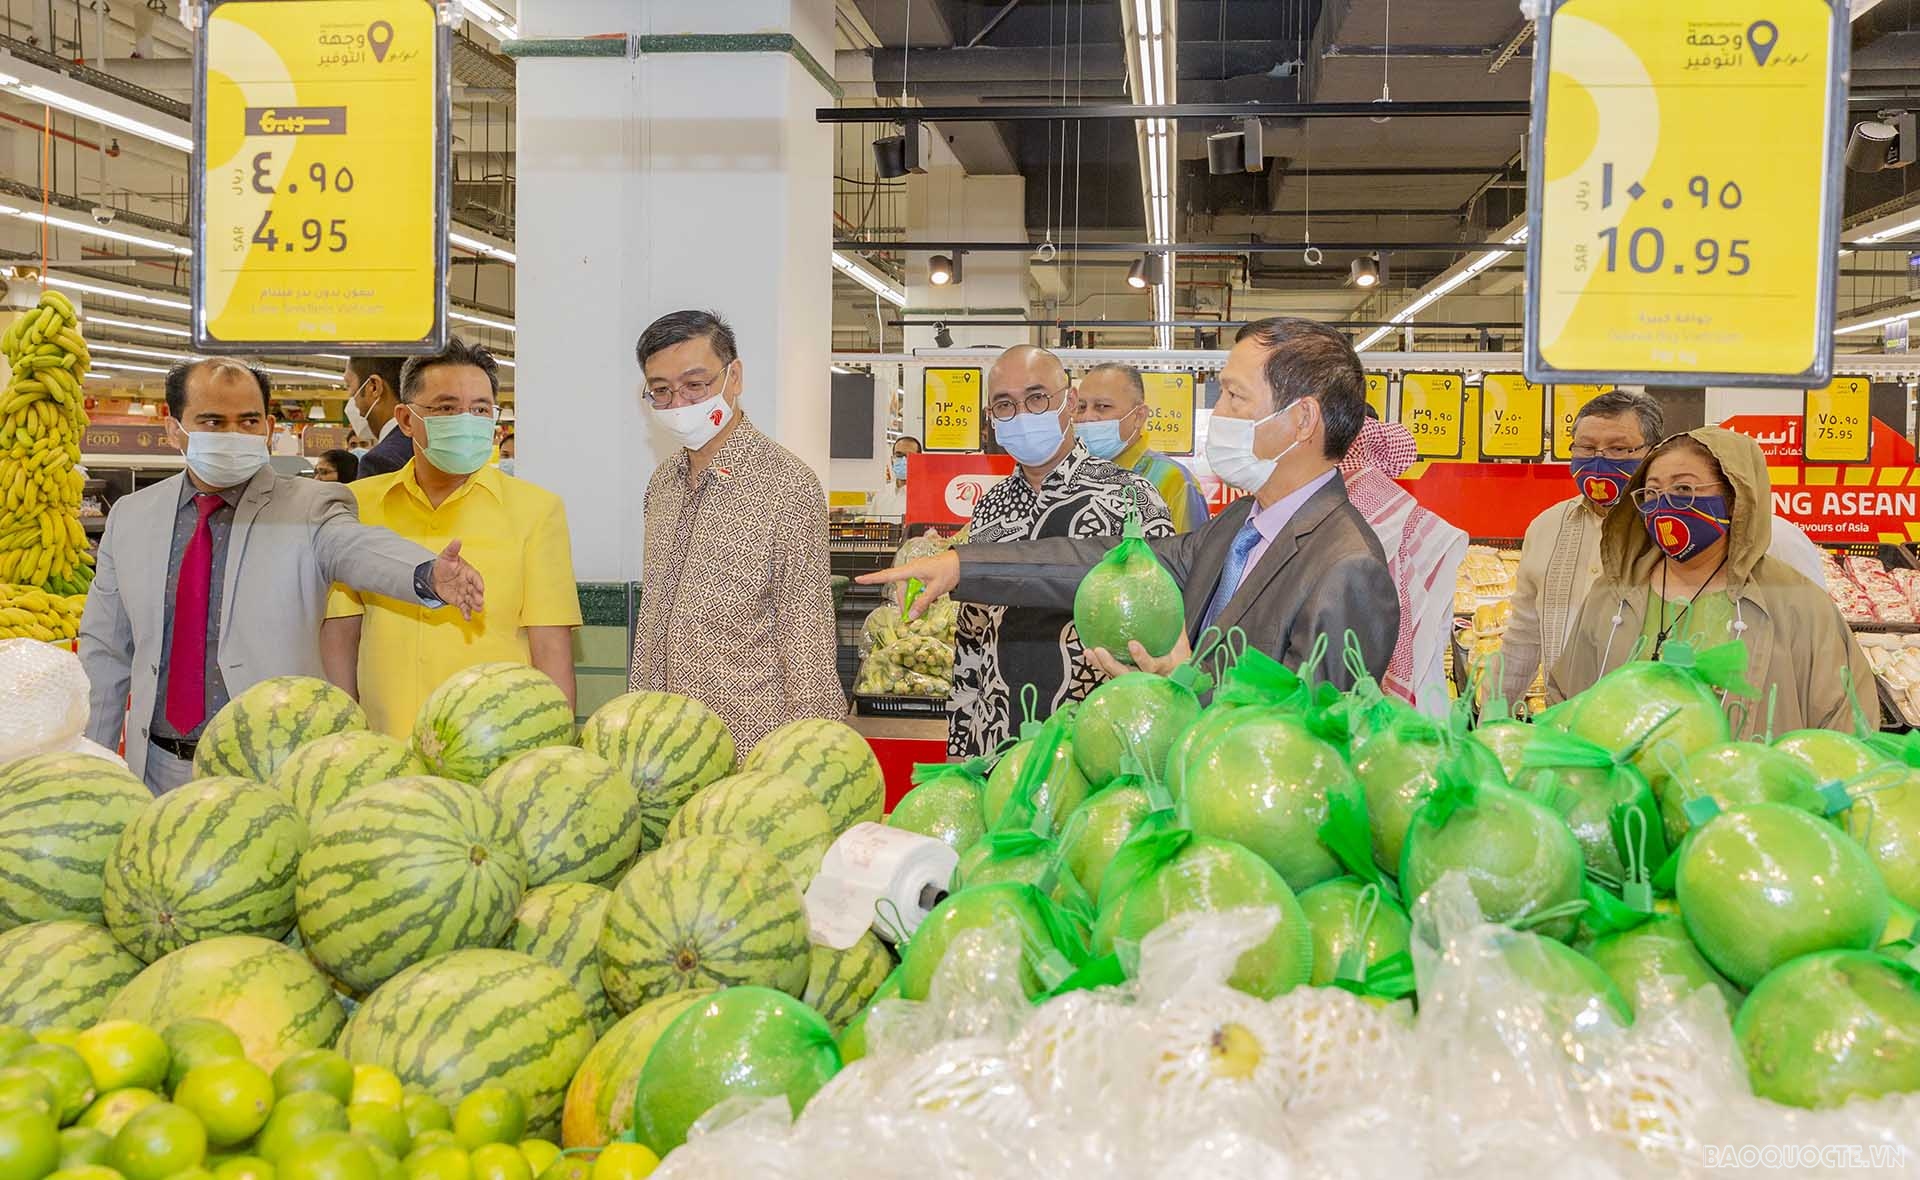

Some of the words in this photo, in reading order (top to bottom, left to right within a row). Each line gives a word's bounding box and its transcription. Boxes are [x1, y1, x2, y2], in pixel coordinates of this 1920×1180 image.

[252, 151, 354, 195] ٤.٩٥
[1601, 162, 1743, 211] ١٠.٩٥
[233, 225, 245, 252] SAR
[251, 210, 348, 253] 4.95
[1574, 243, 1588, 273] SAR
[1597, 226, 1751, 277] 10.95
[936, 415, 968, 427] 63.95
[1146, 420, 1180, 433] 54.95
[1412, 423, 1447, 436] 39.95
[1493, 423, 1519, 436] 7.50
[1818, 427, 1853, 440] 75.95
[1771, 491, 1812, 516] NG
[1821, 491, 1917, 517] ASEAN
[1835, 522, 1847, 533] of
[1848, 522, 1870, 533] Asia
